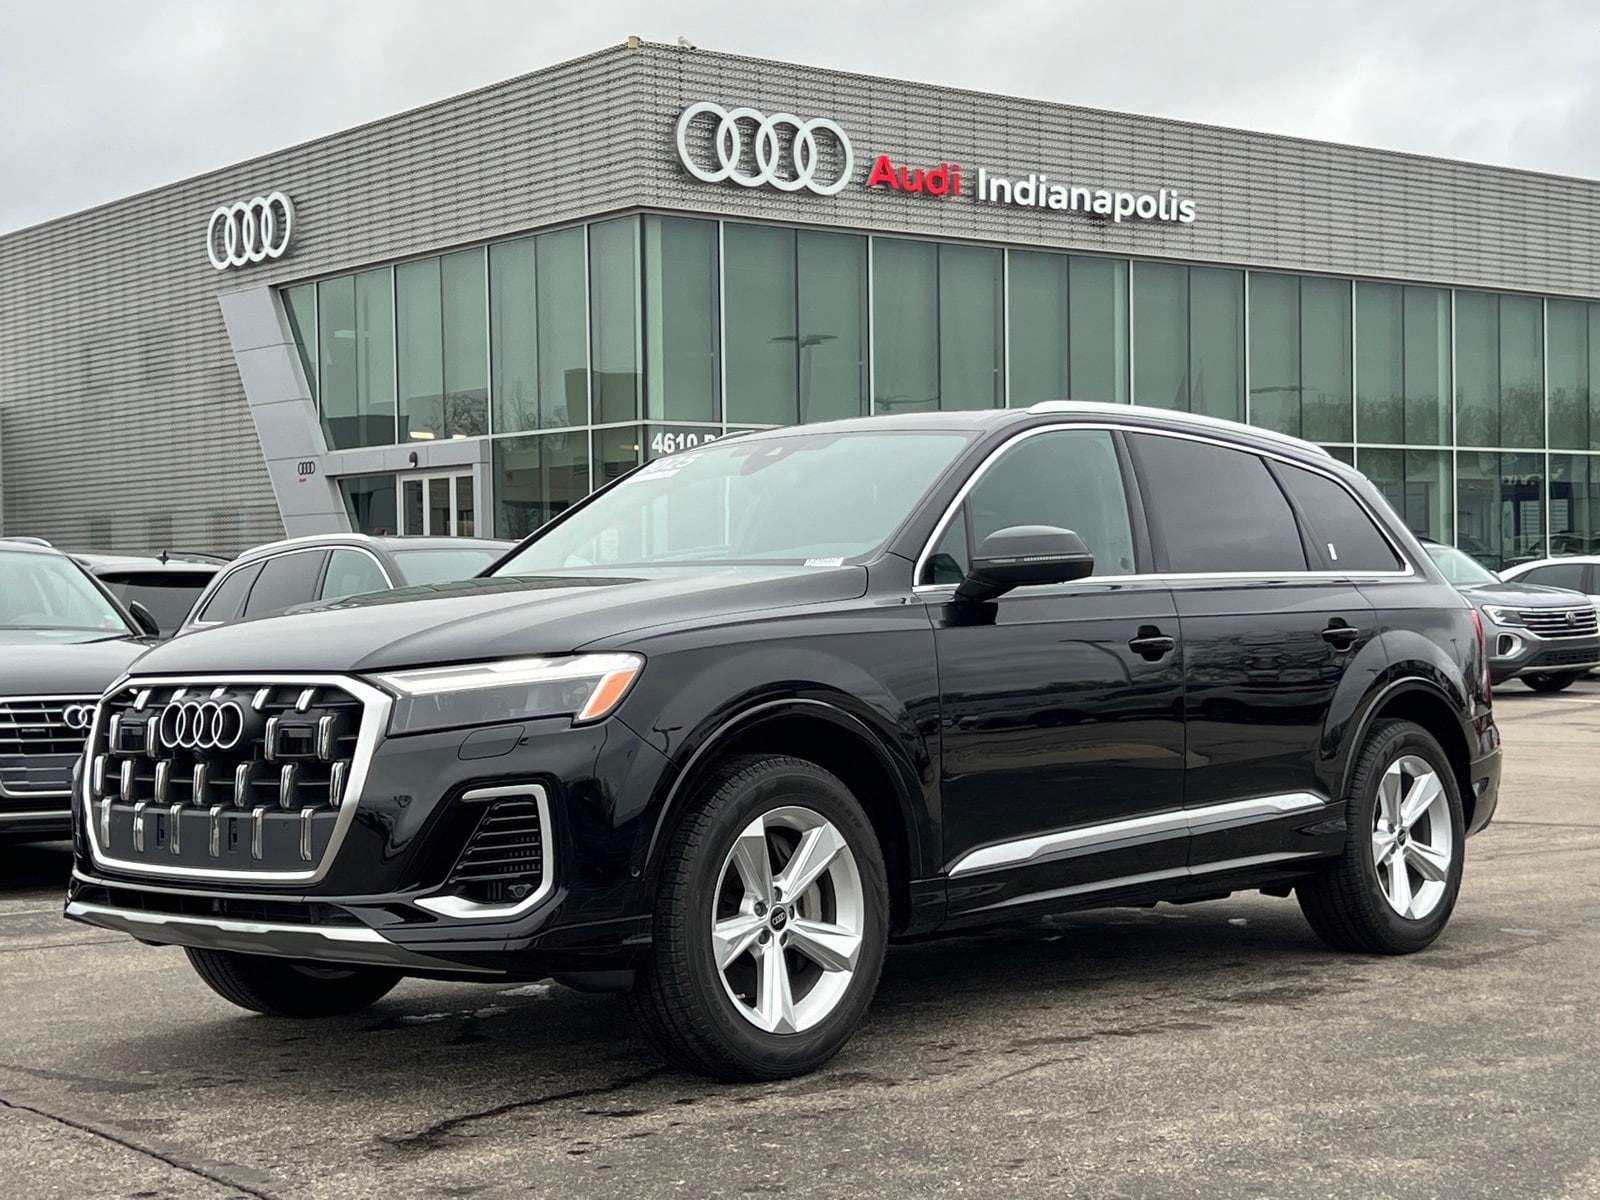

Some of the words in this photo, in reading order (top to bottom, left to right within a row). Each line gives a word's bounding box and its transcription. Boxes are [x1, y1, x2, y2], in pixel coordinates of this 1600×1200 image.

[867, 154, 962, 197] Audi
[977, 167, 1197, 223] Indianapolis
[651, 432, 698, 454] 4610
